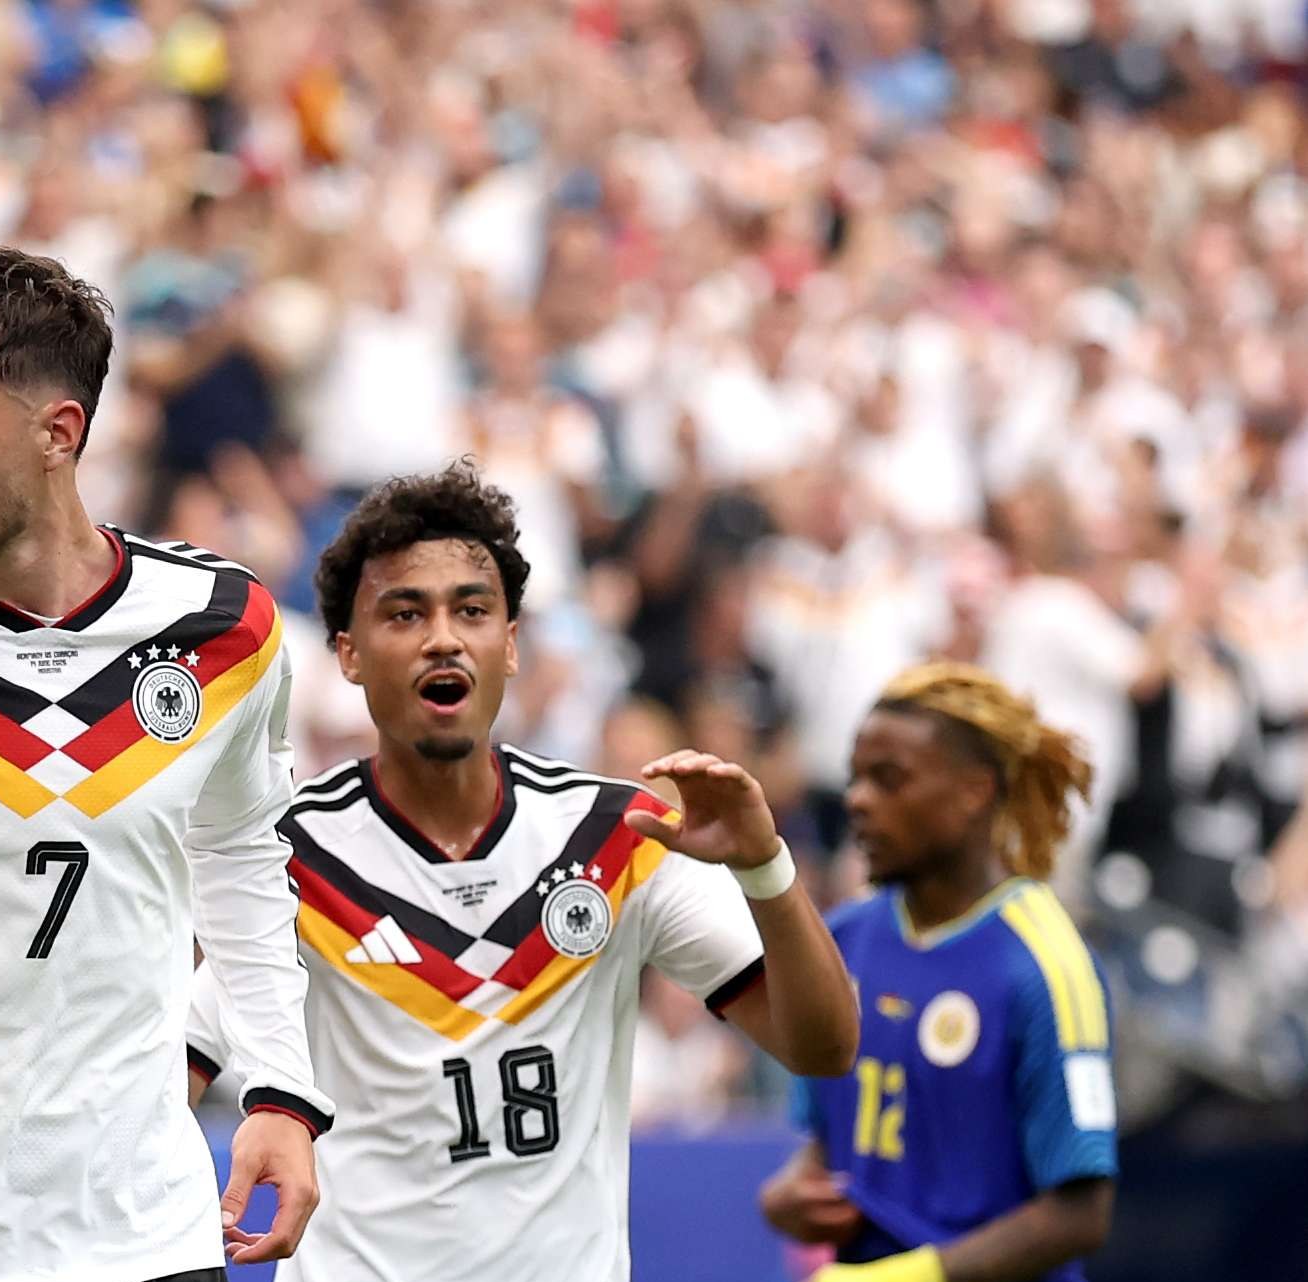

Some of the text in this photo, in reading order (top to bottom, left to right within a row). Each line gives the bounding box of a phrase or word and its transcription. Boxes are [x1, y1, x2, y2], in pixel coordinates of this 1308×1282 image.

[25, 840, 90, 959] 7
[442, 1044, 559, 1164] 18
[854, 1056, 906, 1161] 12
